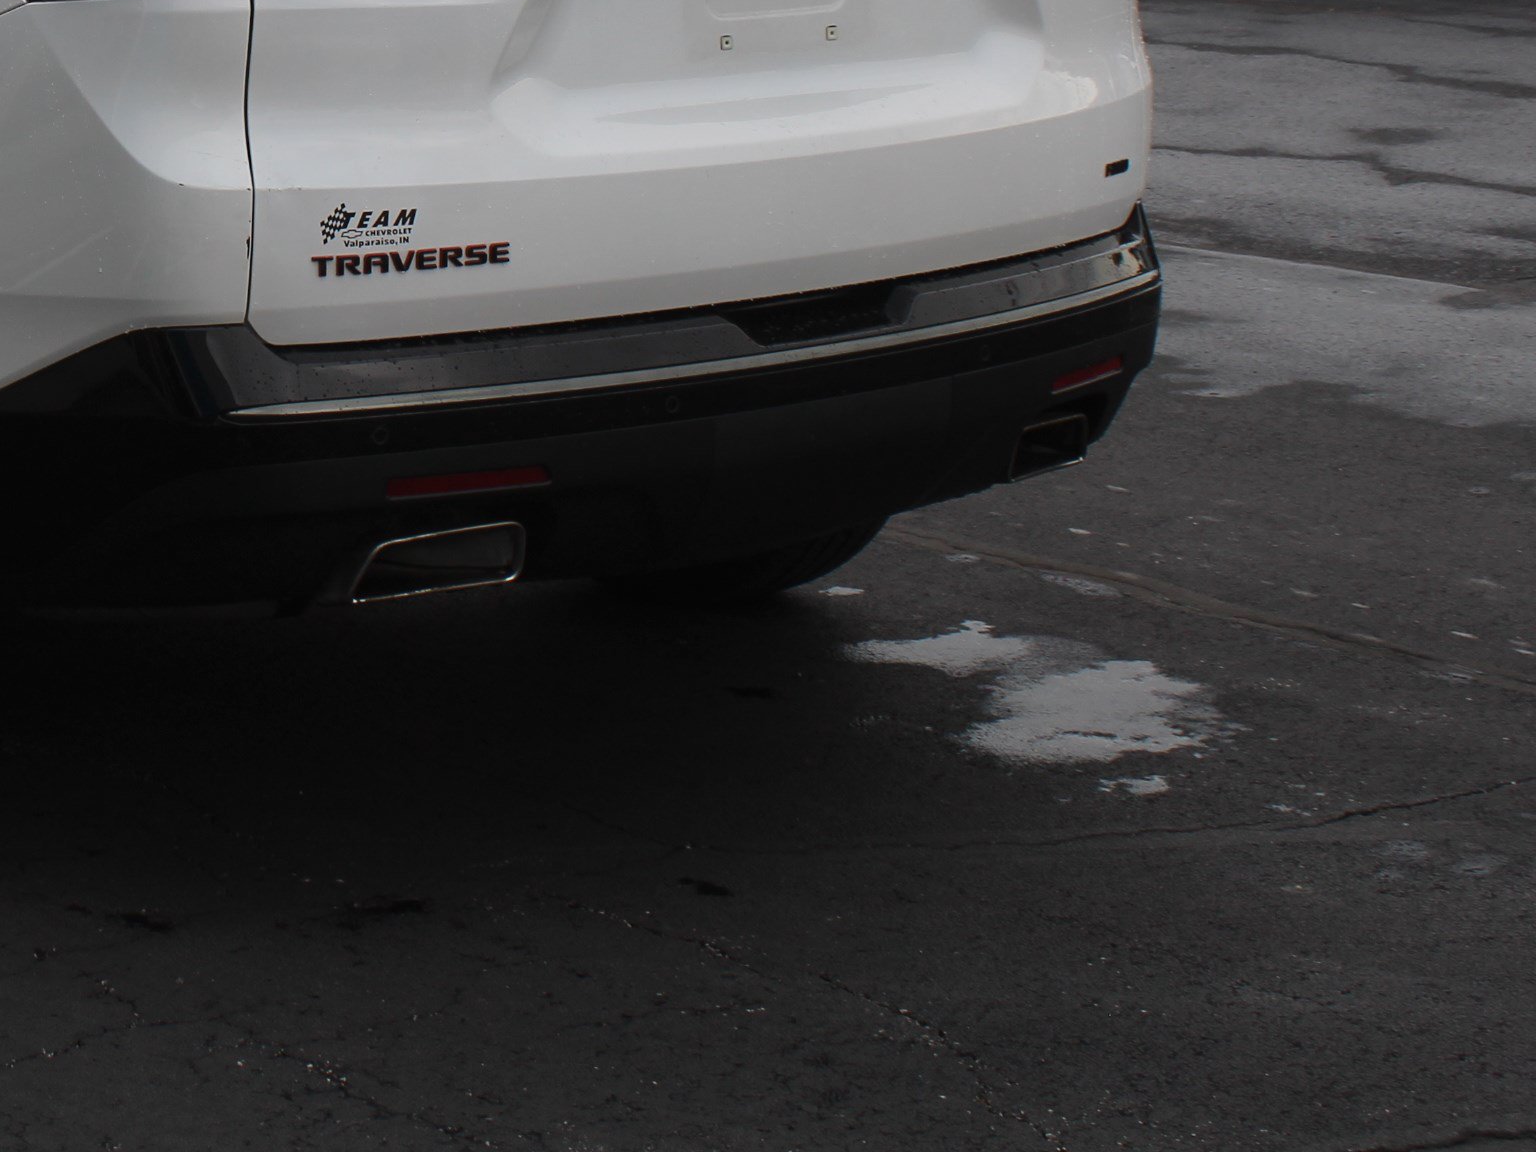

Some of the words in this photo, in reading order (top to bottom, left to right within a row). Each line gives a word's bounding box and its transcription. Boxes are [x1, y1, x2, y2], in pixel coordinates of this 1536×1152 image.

[342, 208, 417, 230] TEAM
[365, 227, 413, 237] CHEVROLET
[344, 237, 398, 248] Valparaiso,
[399, 236, 410, 244] IN
[311, 241, 511, 278] TRAVERSE
